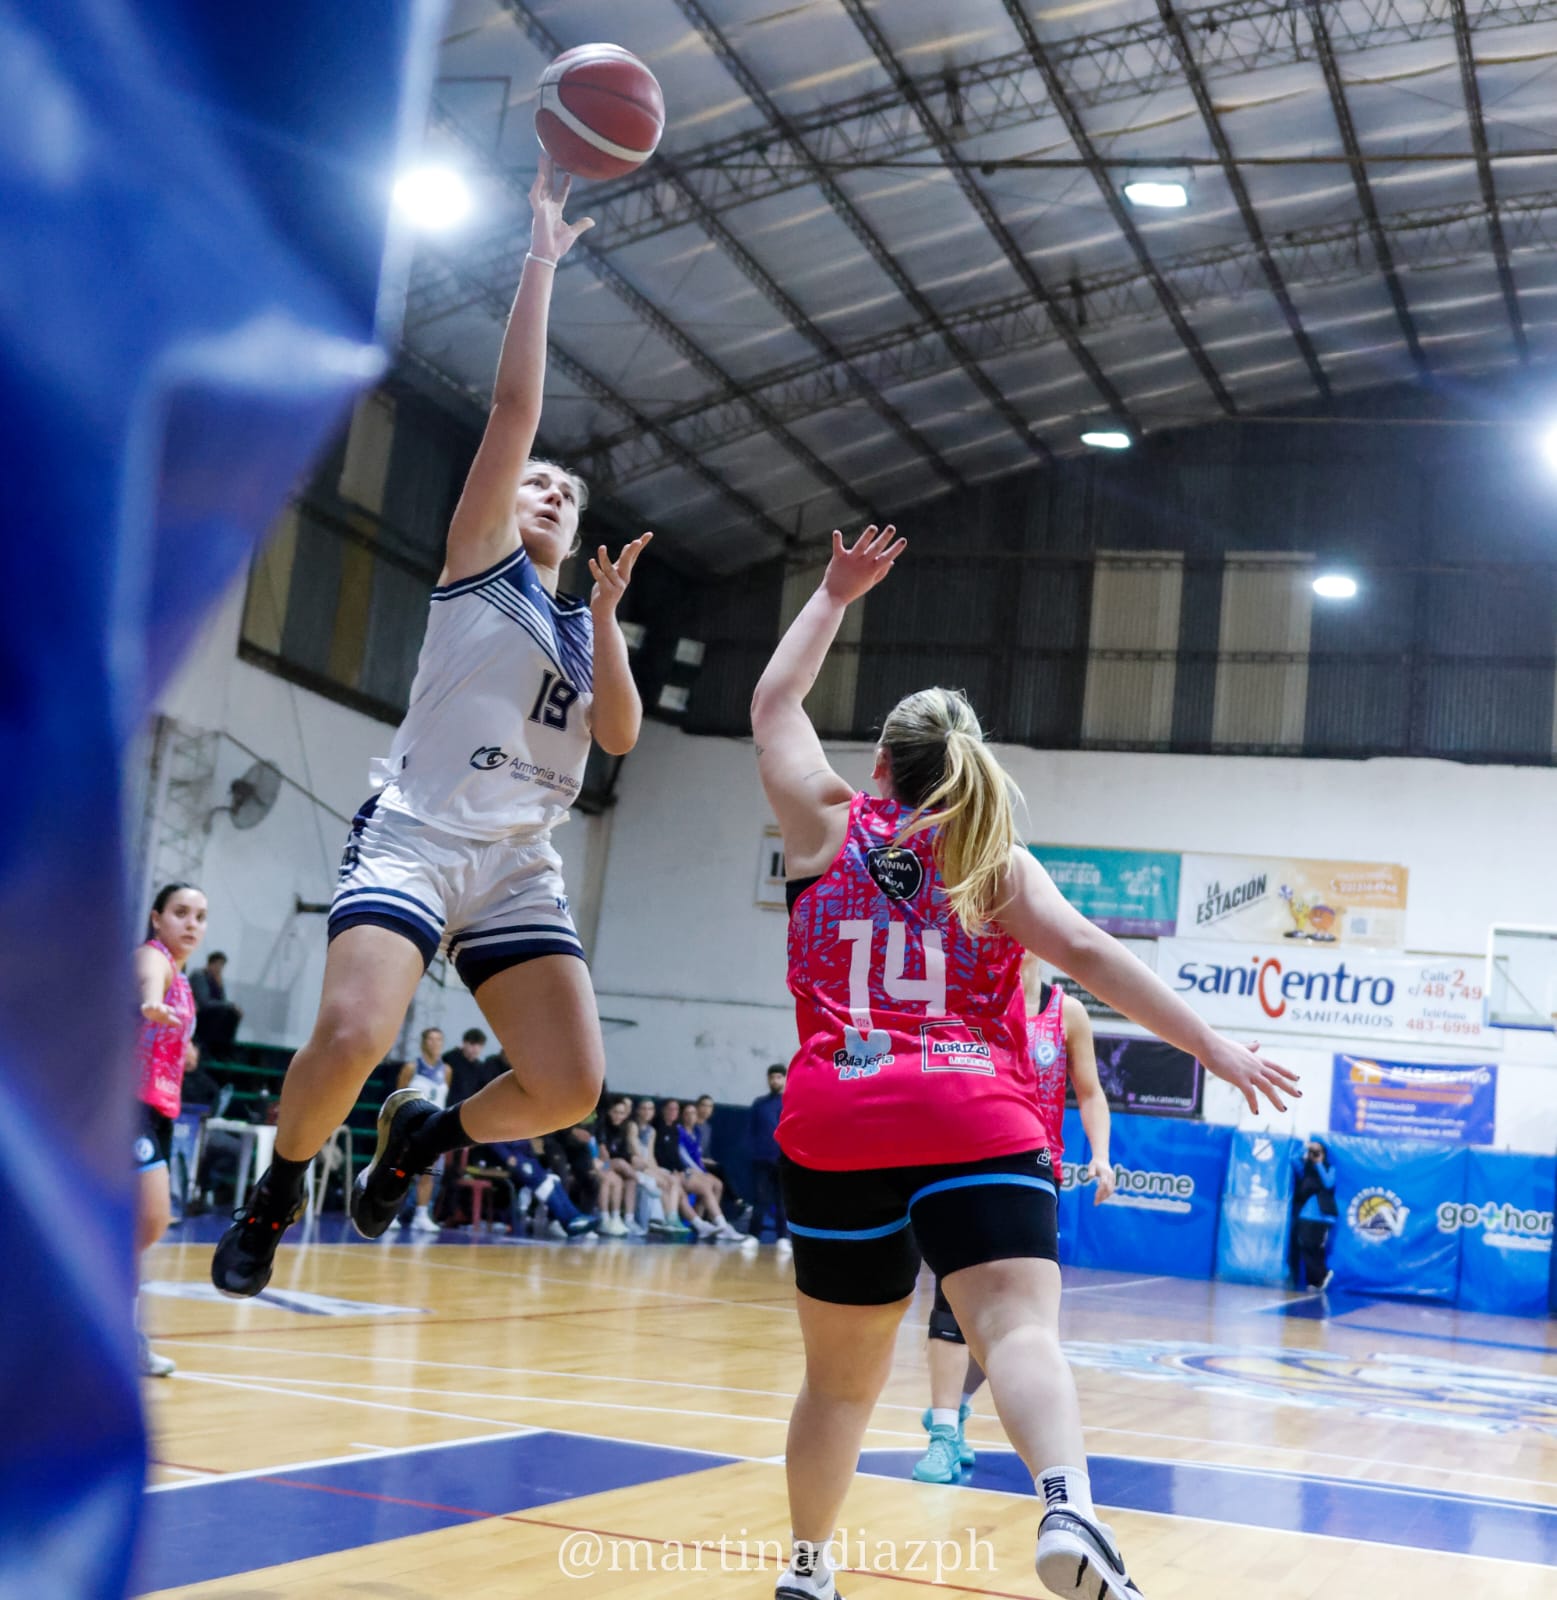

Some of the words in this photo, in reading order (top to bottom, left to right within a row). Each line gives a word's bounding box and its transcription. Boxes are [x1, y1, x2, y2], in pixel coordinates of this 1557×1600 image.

[528, 669, 578, 731] 19
[1207, 880, 1220, 899] LA
[839, 919, 947, 1031] 14
[1452, 969, 1465, 988] 2
[1175, 956, 1395, 1019] saniCentro
[1424, 983, 1446, 998] 48
[1460, 985, 1483, 1000] 49
[1291, 1007, 1394, 1028] SANITARIOS
